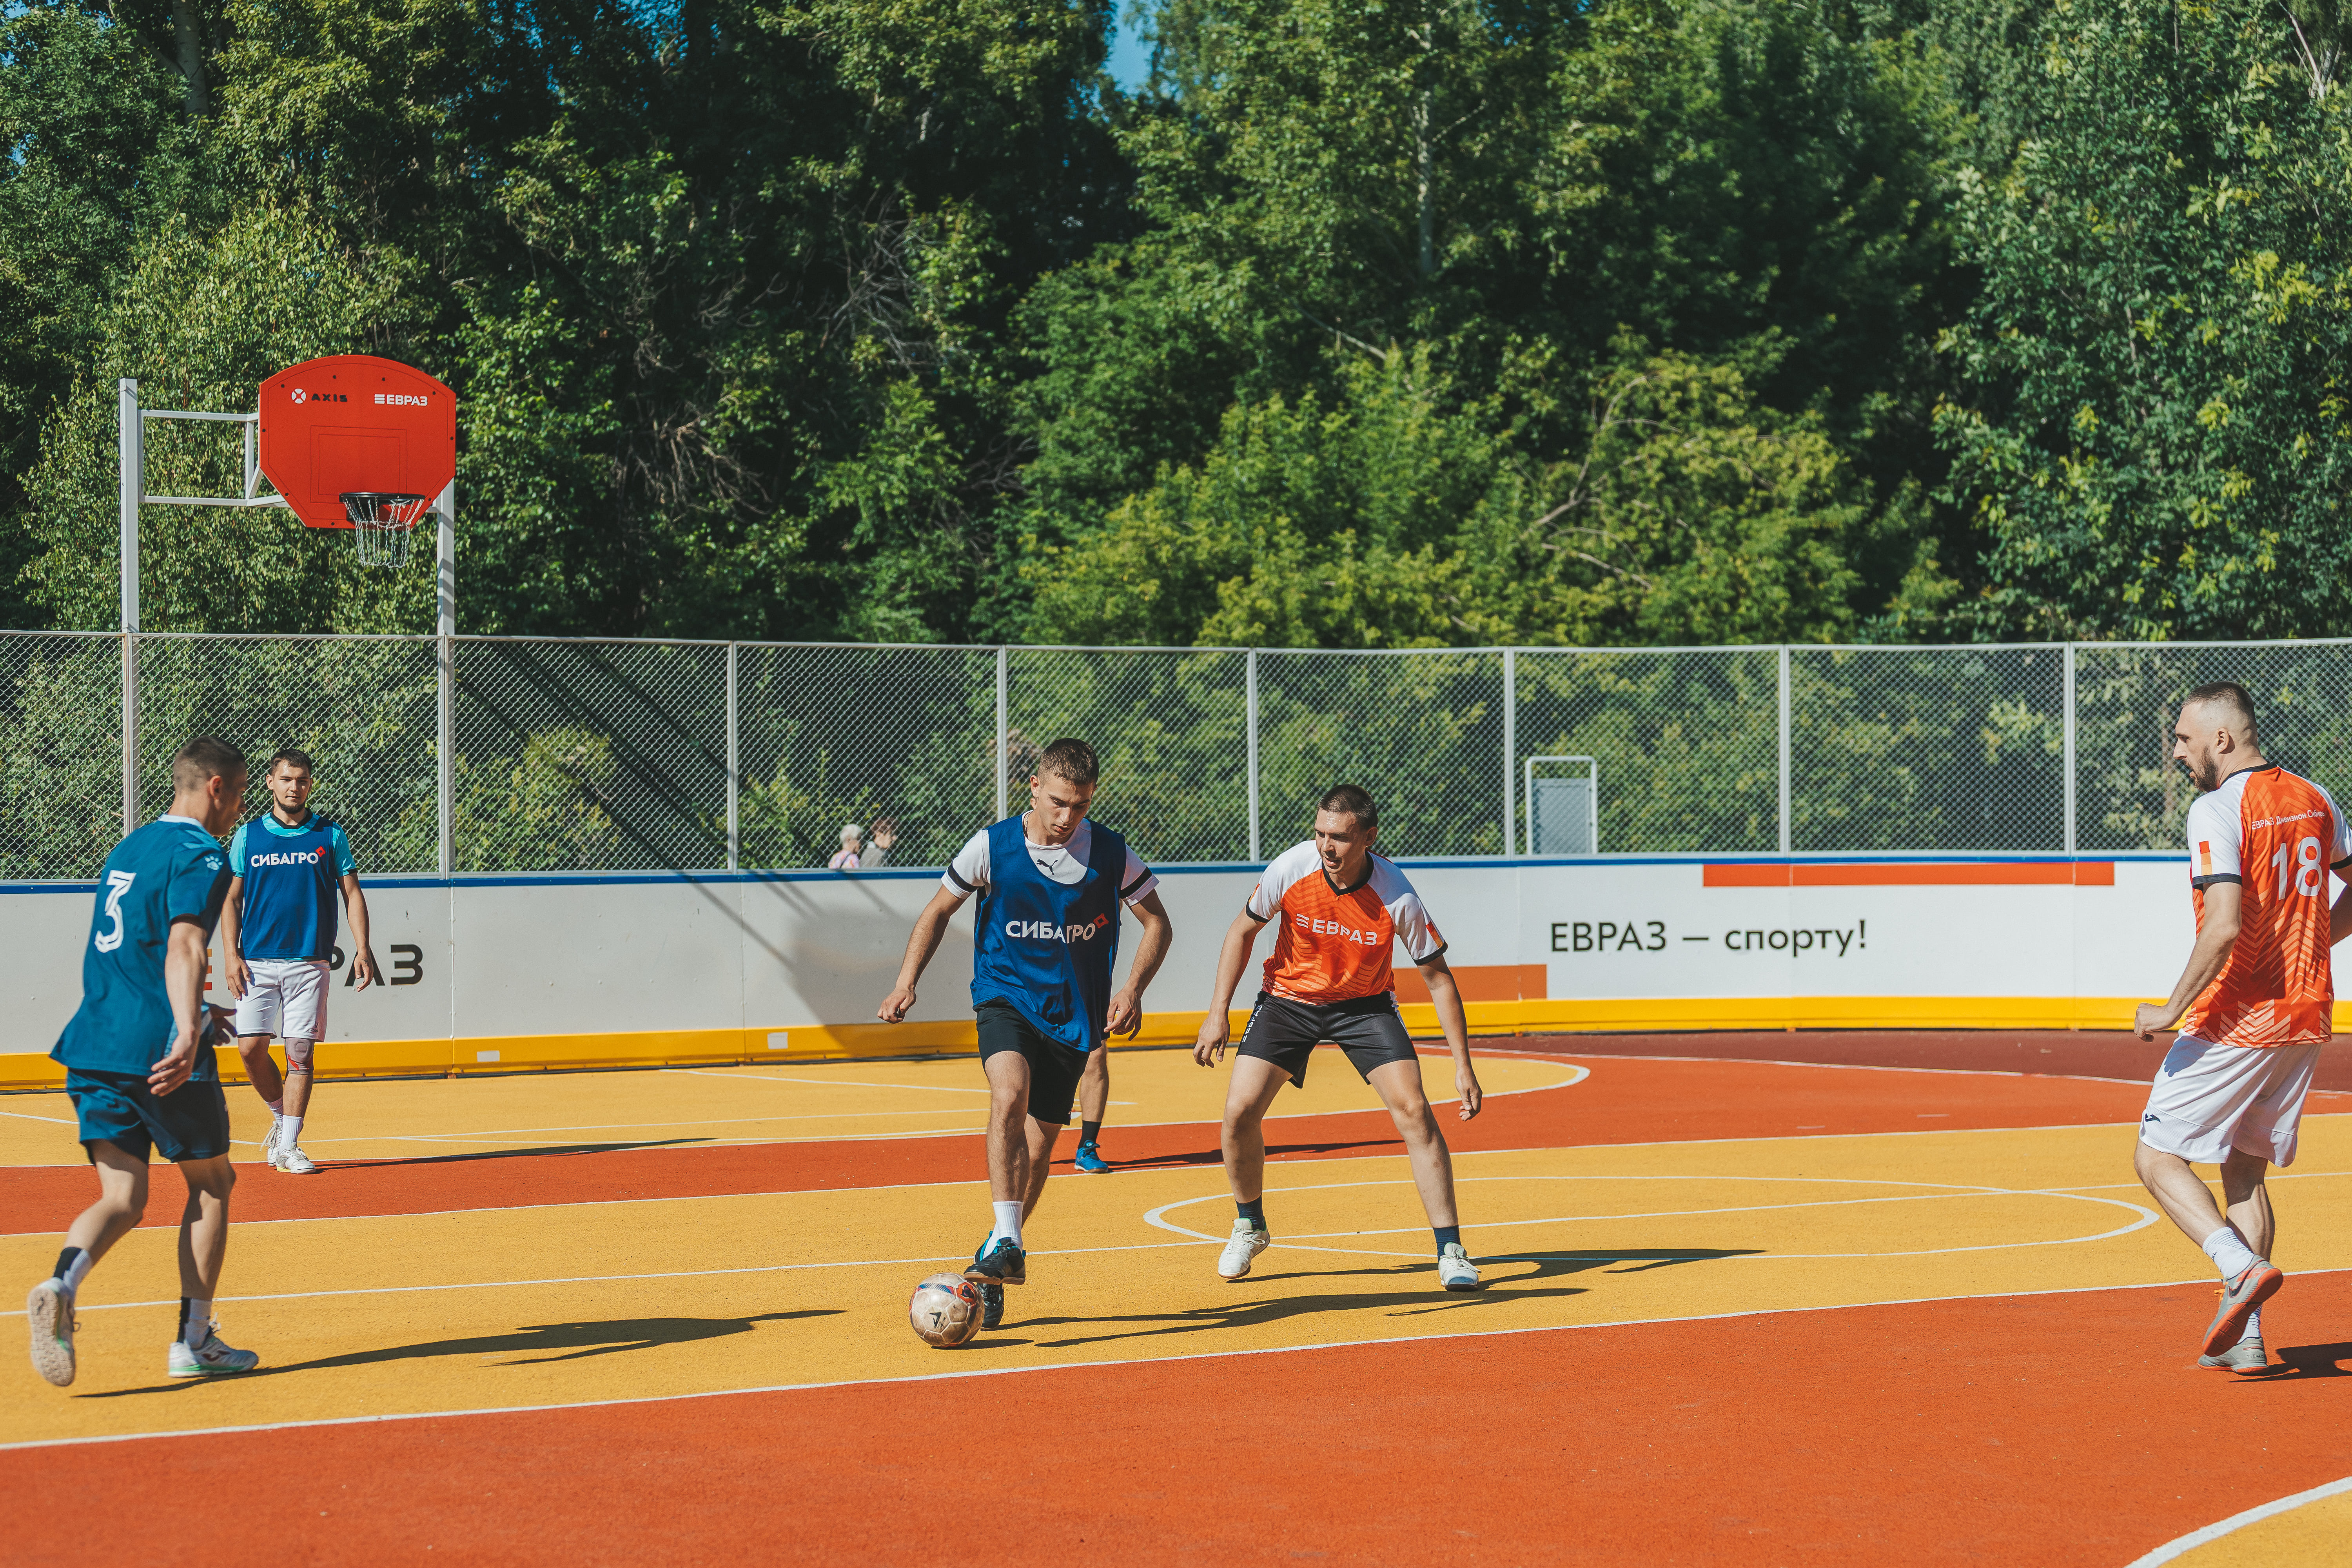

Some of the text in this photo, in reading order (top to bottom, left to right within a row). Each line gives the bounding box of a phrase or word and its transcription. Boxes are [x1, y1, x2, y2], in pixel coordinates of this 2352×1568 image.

[312, 393, 347, 402] AXIS
[387, 394, 428, 406] ЕВРАЗ
[2276, 813, 2307, 826] Дивизион
[251, 852, 319, 867] СИБАГРО
[2272, 836, 2323, 900] 18
[94, 870, 137, 953] 3
[1005, 921, 1096, 944] СИБАГРО
[1312, 918, 1377, 945] ЕВРАЗ
[1551, 921, 1666, 952] ЕВРАЗ
[1725, 919, 1866, 957] спорту!
